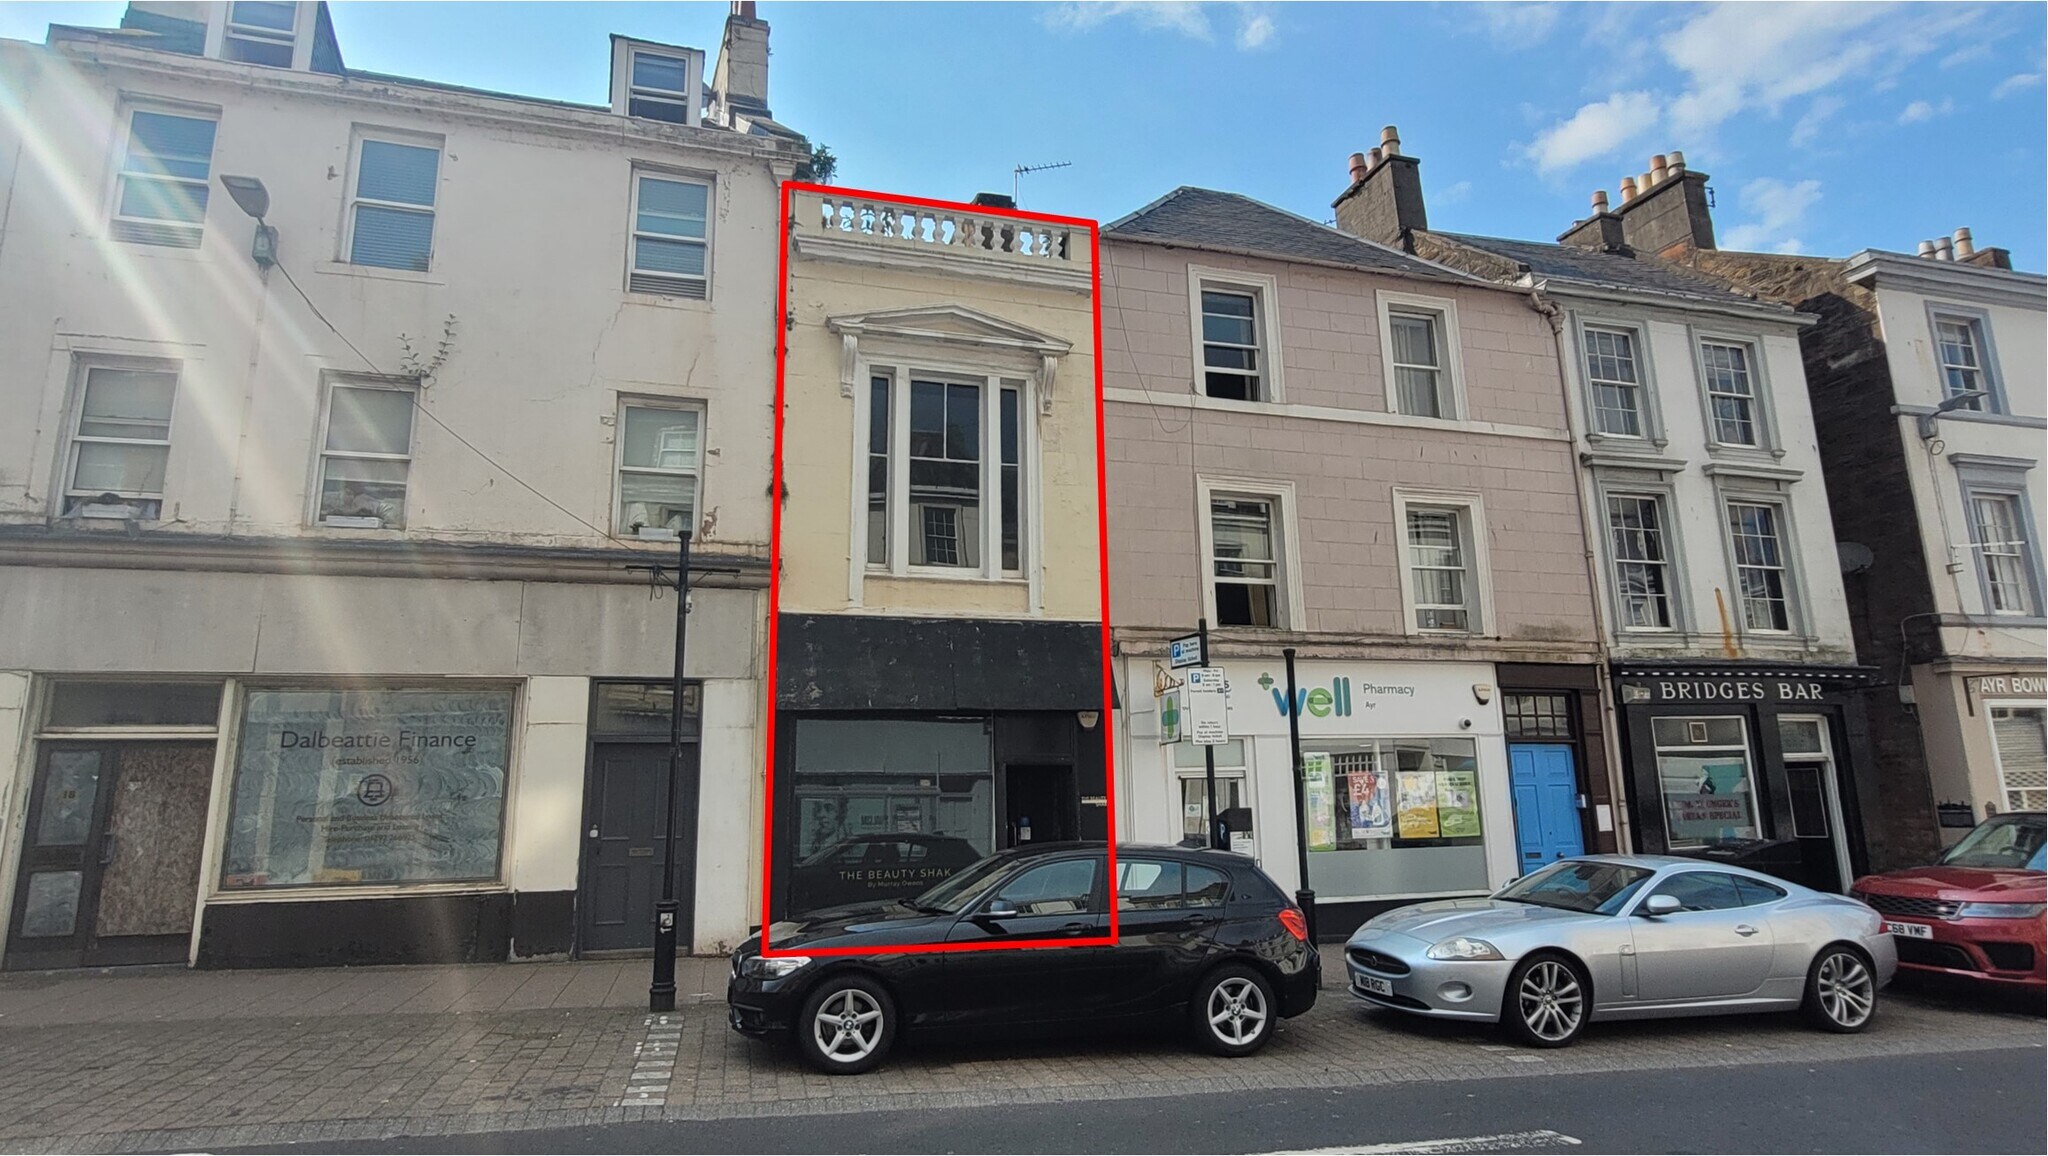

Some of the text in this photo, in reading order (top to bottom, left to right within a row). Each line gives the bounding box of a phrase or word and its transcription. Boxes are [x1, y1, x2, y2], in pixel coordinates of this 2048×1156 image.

[1362, 683, 1415, 698] Pharmacy
[1659, 681, 1765, 700] BRIDGES
[1777, 682, 1824, 700] BAR
[1981, 677, 2007, 693] AYR
[1272, 676, 1352, 717] well
[1365, 701, 1376, 709] Ayr
[280, 730, 477, 749] Dalbeattie Finance
[1353, 783, 1370, 797] £4
[839, 868, 952, 880] THE BEAUTY SHAK
[867, 881, 877, 889] By
[877, 881, 900, 889] Murray
